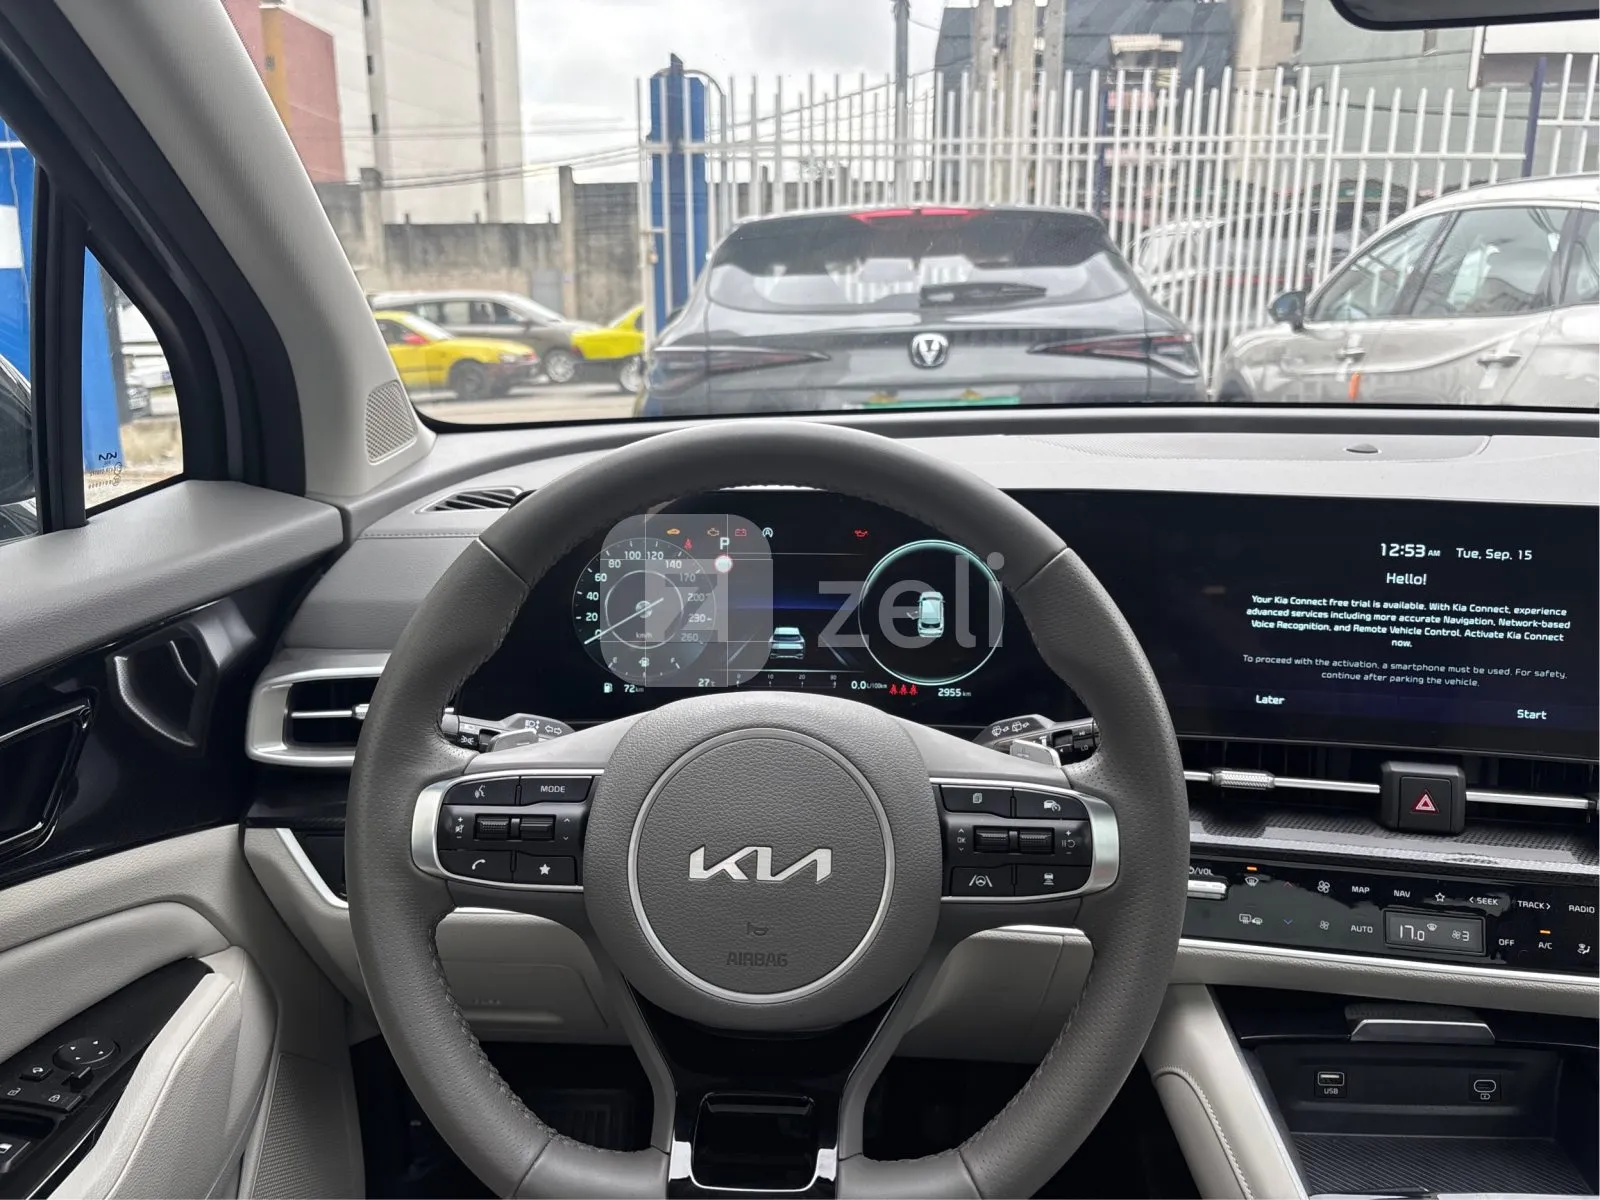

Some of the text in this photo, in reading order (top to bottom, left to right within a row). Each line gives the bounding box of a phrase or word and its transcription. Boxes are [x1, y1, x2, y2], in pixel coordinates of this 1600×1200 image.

[719, 537, 730, 550] P
[624, 551, 641, 560] 100
[646, 551, 664, 560] 120
[1380, 543, 1441, 558] 12:53 AM
[1485, 548, 1513, 561] Sep.
[1518, 549, 1533, 561] 15
[608, 559, 621, 569] 80
[665, 560, 682, 569] 140
[594, 572, 607, 582] 60
[679, 572, 696, 582] 170
[1386, 572, 1427, 586] Hello!
[586, 591, 599, 601] 40
[687, 592, 705, 602] 200
[1252, 594, 1273, 604] Your
[1274, 596, 1288, 605] Kia
[1290, 596, 1327, 606] Connect
[1329, 598, 1349, 607] free
[1351, 599, 1371, 608] trial
[1373, 600, 1381, 609] is
[1428, 602, 1450, 611] With
[1452, 603, 1467, 612] Kia
[1513, 606, 1567, 617] experience
[585, 612, 598, 621] 20
[688, 613, 706, 623] 230
[1246, 607, 1289, 617] advanced
[1291, 610, 1329, 619] services
[1330, 611, 1372, 622] including
[1373, 613, 1397, 622] more
[1398, 614, 1441, 624] accurate
[1498, 618, 1571, 629] Network-based
[1251, 619, 1275, 629] Voice
[1333, 624, 1351, 632] and
[1353, 624, 1387, 634] Remote
[1389, 626, 1422, 635] Vehicle
[1464, 629, 1504, 639] Activate
[1506, 630, 1522, 640] Kia
[1524, 631, 1564, 642] Connect
[680, 632, 699, 642] 260
[1391, 639, 1413, 648] now.
[1242, 654, 1254, 663] To
[1255, 656, 1292, 665] proceed
[1294, 657, 1313, 666] with
[1314, 658, 1330, 666] the
[1390, 663, 1446, 673] smartphone
[1447, 665, 1471, 674] must
[1487, 667, 1513, 676] used.
[1515, 668, 1532, 677] For
[697, 678, 710, 687] 27
[1321, 671, 1480, 687] continue after parking the vehicle.
[938, 687, 962, 697] 2955
[1255, 694, 1285, 705] Later
[1516, 709, 1548, 720] Start
[540, 784, 566, 794] MODE
[688, 845, 832, 884] KIA
[1351, 885, 1371, 894] MAP
[1393, 889, 1411, 898] NAV
[1476, 897, 1499, 906] SEEK
[1517, 900, 1545, 910] TRACK
[1568, 904, 1595, 914] RADIO
[1350, 924, 1373, 934] AUTO
[1400, 924, 1425, 941] 17.0
[1461, 930, 1470, 942] 3
[1498, 938, 1515, 947] OFF
[1538, 941, 1553, 950] A/C
[726, 951, 788, 967] AIRBAG
[1324, 1087, 1338, 1095] USB
